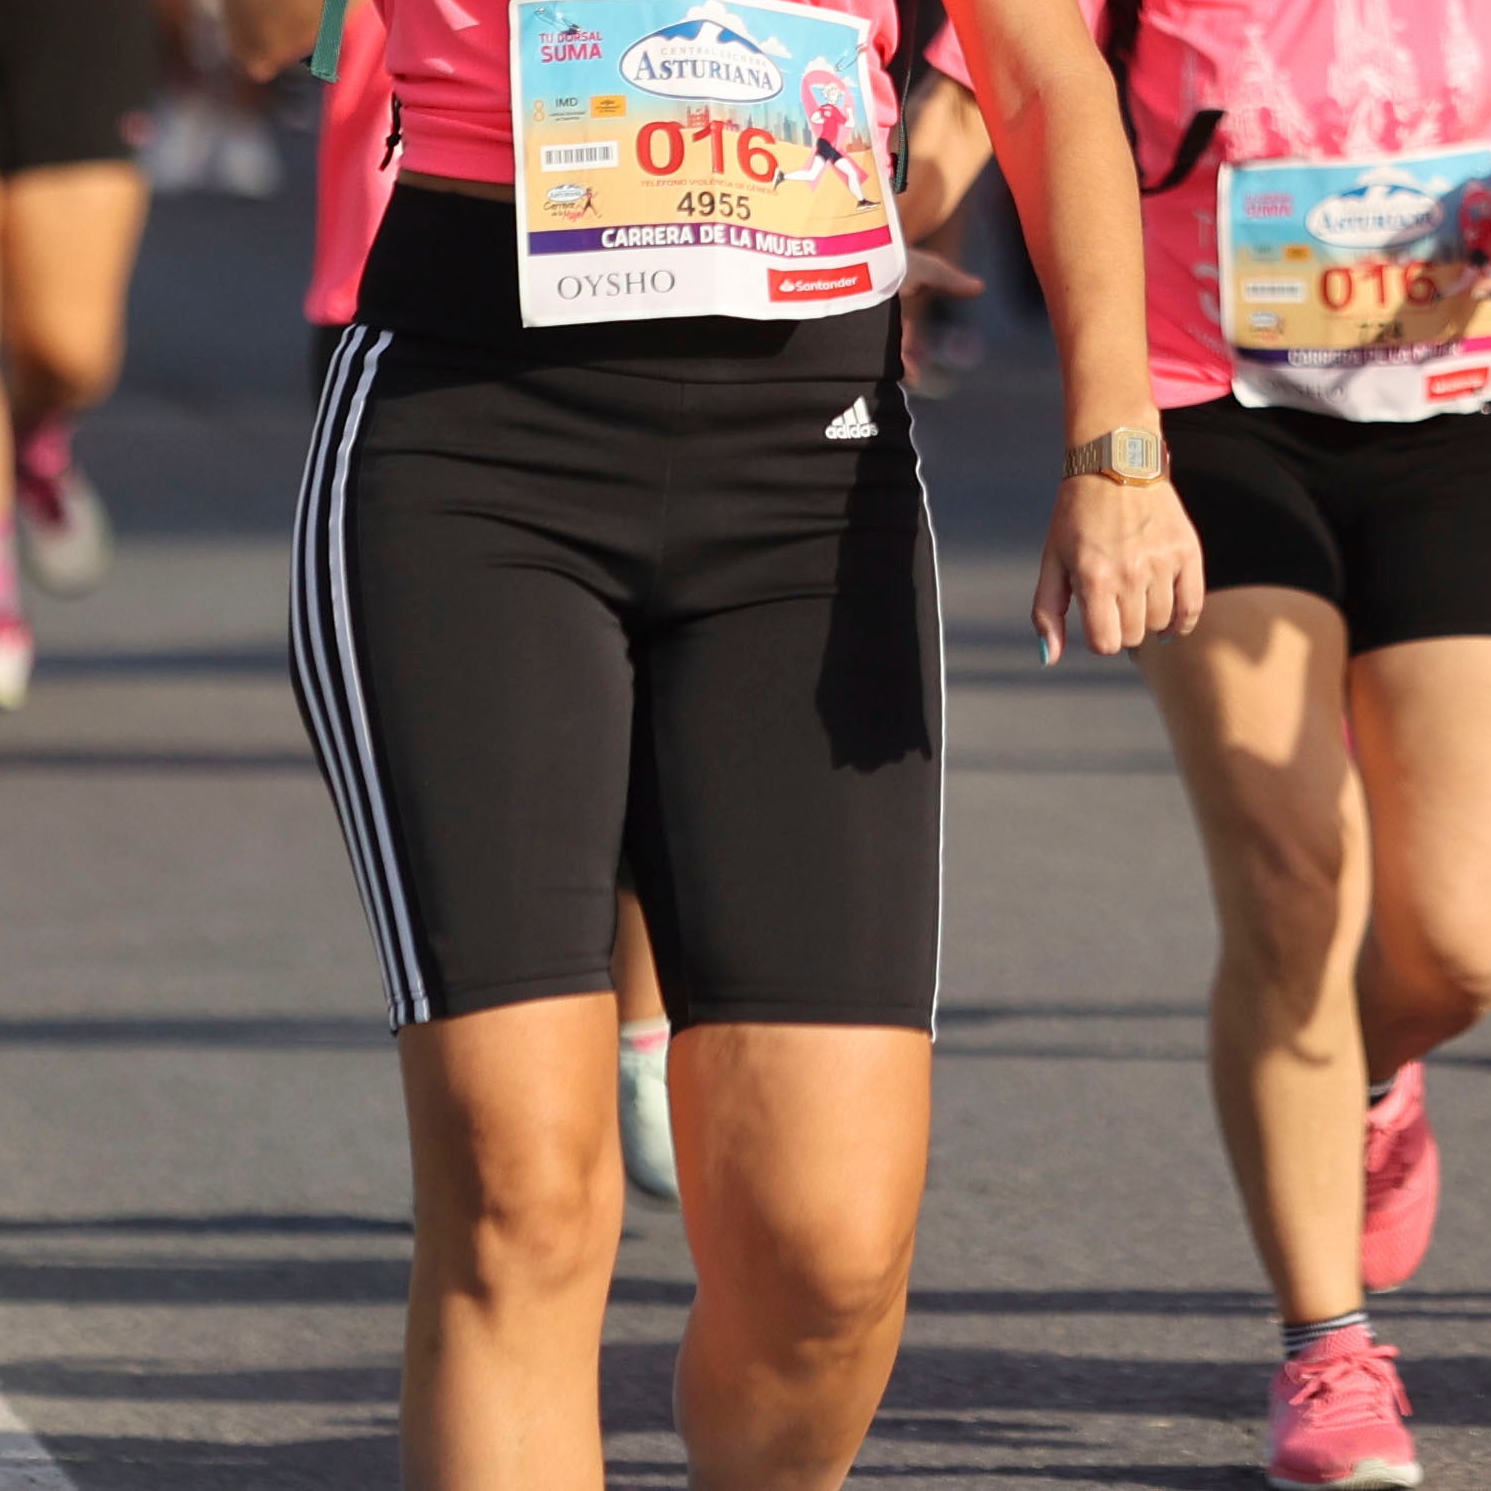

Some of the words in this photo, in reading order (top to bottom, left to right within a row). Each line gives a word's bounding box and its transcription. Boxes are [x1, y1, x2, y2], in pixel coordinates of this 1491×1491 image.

[539, 33, 554, 44] TU
[540, 43, 602, 63] SUMA
[634, 50, 775, 91] ASTURIANA
[555, 97, 578, 107] IMD
[636, 120, 779, 184] 016
[677, 190, 751, 221] 4955
[601, 225, 695, 248] CARRERA
[699, 223, 726, 245] DE
[729, 227, 753, 249] LA
[755, 232, 818, 257] MUJER
[556, 269, 676, 300] OYSHO
[795, 274, 858, 293] Santander
[1321, 262, 1437, 311] 016
[825, 423, 878, 439] adidas
